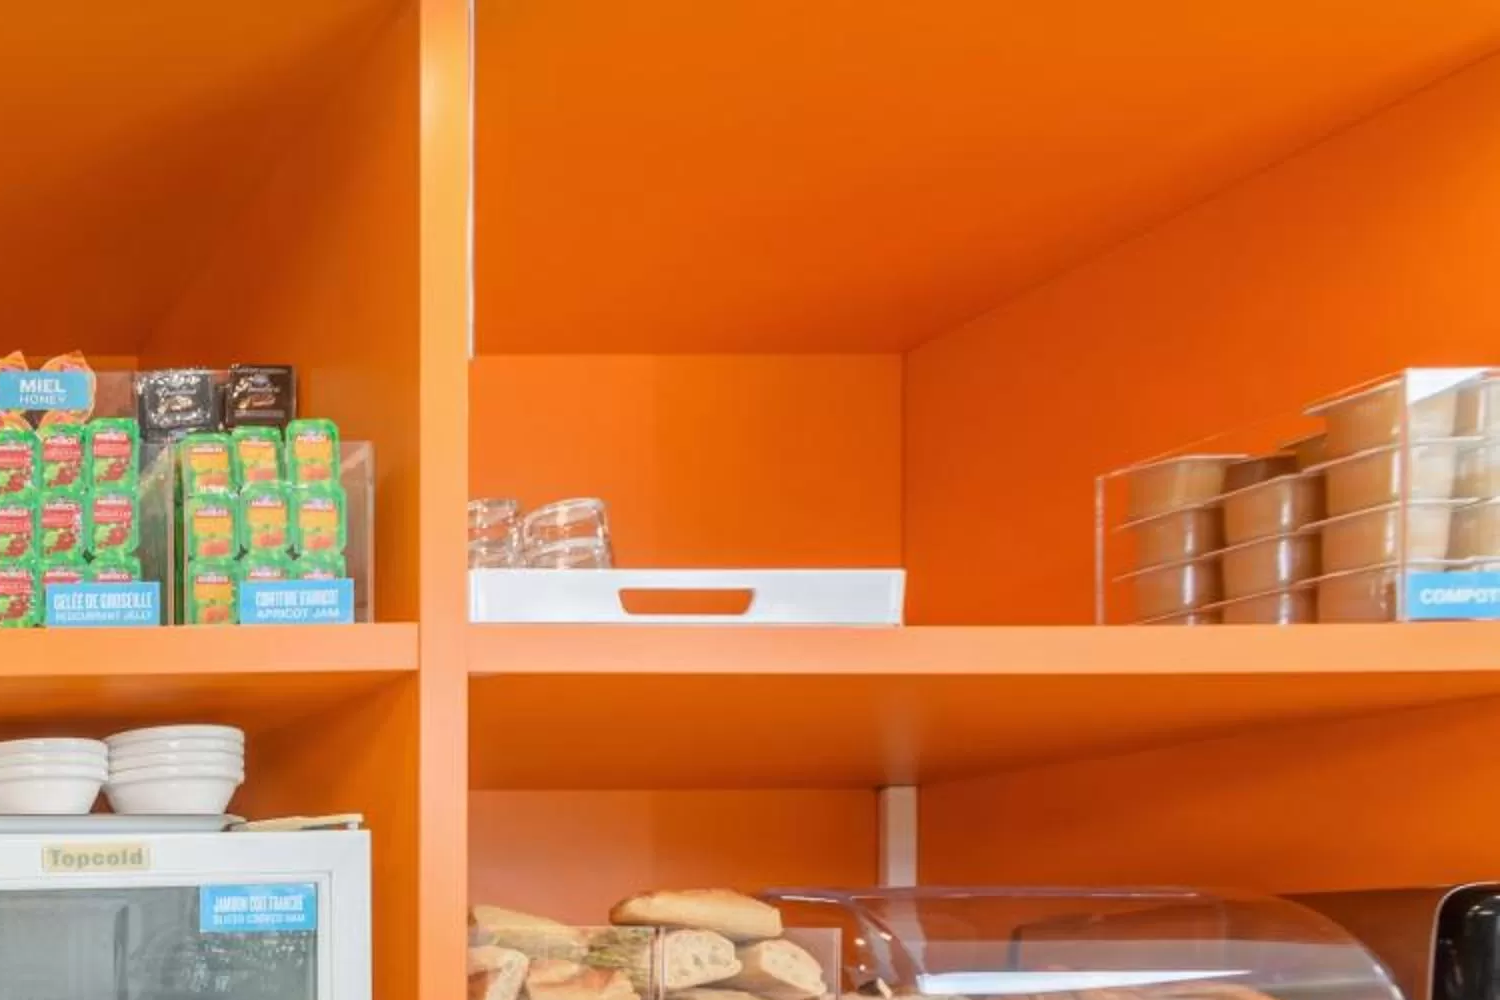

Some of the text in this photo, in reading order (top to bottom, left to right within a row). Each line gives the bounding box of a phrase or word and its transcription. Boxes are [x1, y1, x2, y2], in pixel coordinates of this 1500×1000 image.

[19, 378, 67, 393] MIEL
[19, 394, 67, 405] HONEY
[50, 846, 143, 869] Topcold
